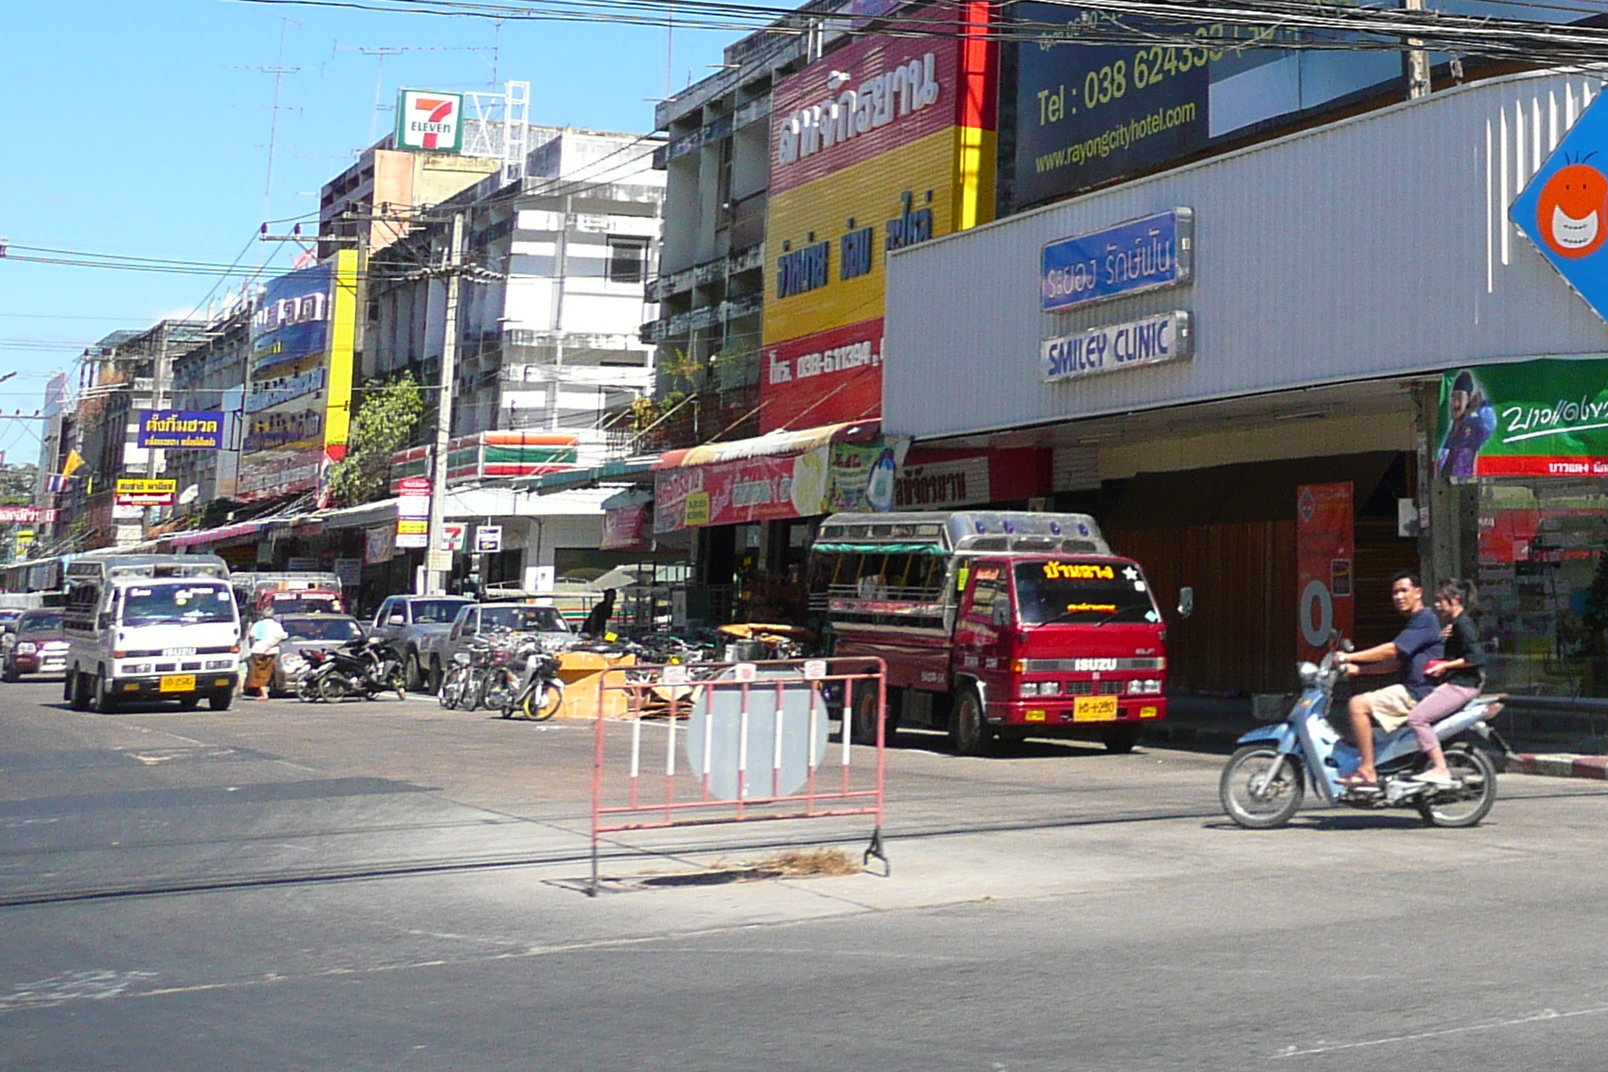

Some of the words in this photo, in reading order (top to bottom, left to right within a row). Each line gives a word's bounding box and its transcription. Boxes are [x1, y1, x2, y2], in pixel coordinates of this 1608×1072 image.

[1037, 85, 1065, 126] Tel
[1084, 60, 1127, 109] 038
[1133, 24, 1224, 90] 624333
[415, 98, 453, 148] 7
[1035, 102, 1196, 173] www.rayongcityhotel.com
[1048, 260, 1097, 298] ระยอง
[1048, 332, 1107, 376] SMILEY
[1114, 320, 1169, 362] CLINIC
[1074, 658, 1117, 671] ISUZU
